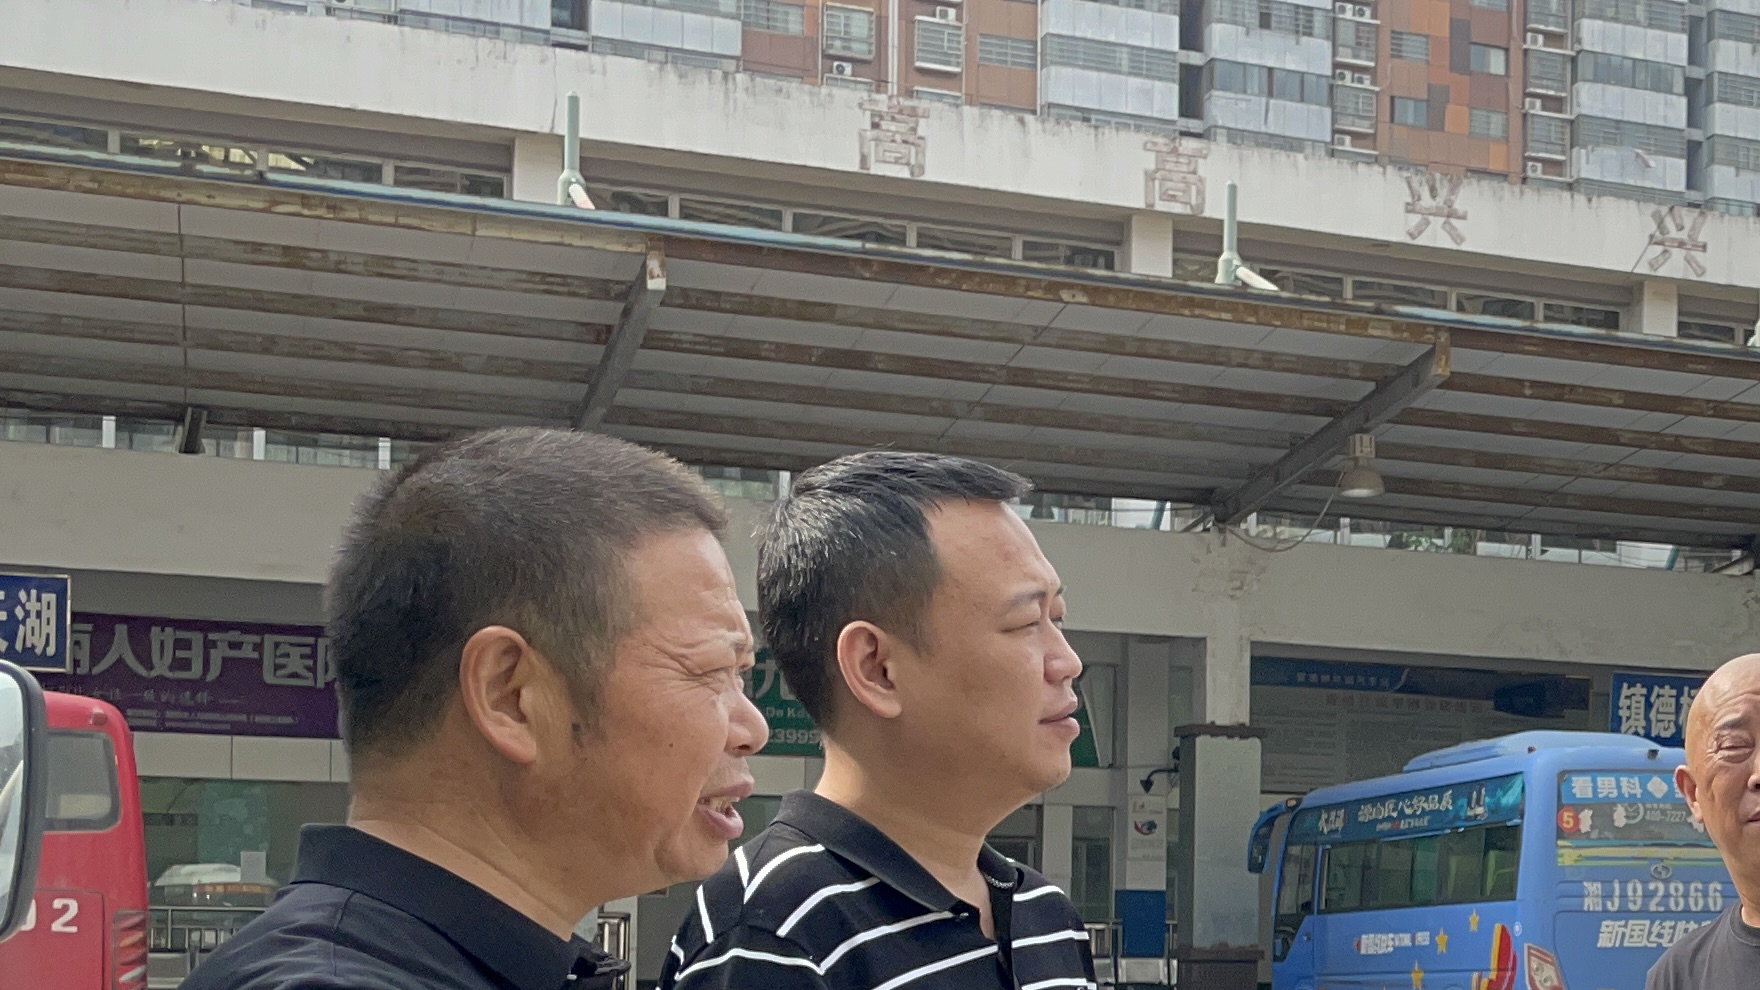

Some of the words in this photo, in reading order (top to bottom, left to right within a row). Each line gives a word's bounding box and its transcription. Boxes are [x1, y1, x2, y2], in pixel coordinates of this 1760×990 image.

[1571, 776, 1643, 799] 看男科
[1562, 812, 1574, 829] 5
[1596, 919, 1712, 948] 新国线
